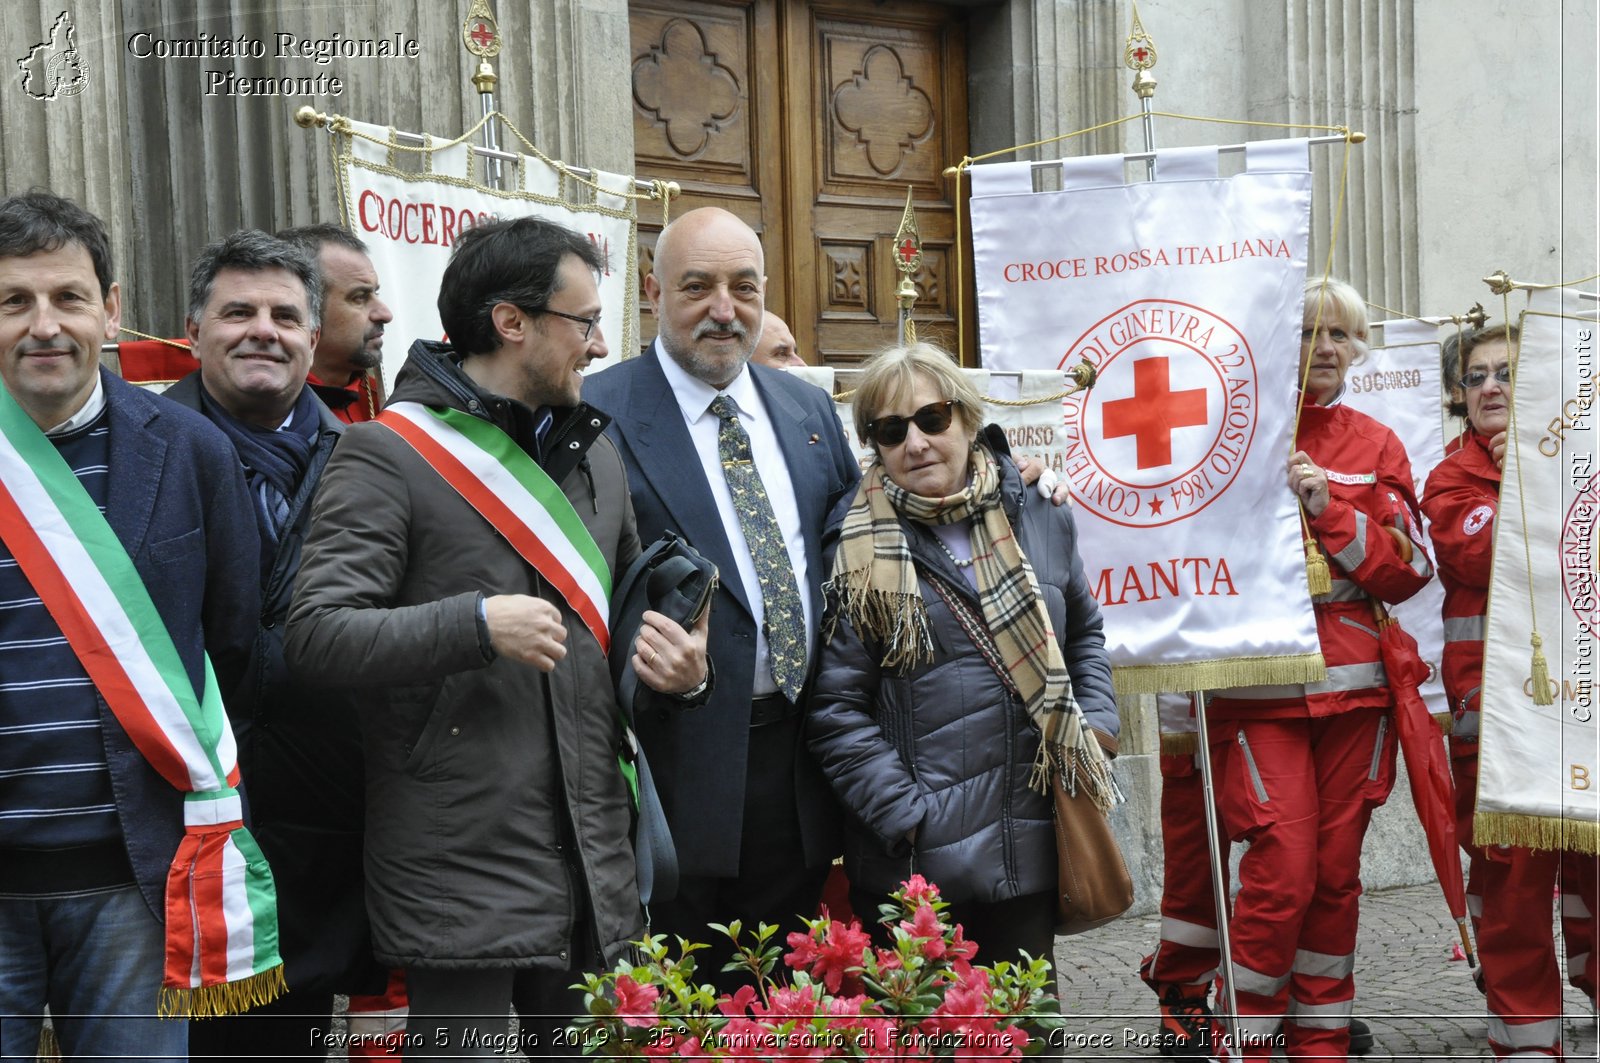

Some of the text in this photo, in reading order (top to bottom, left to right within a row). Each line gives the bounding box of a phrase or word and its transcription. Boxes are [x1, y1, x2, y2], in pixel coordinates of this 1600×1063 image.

[1003, 239, 1291, 283] CROCE ROSSA ITALIANA
[1109, 309, 1216, 350] GINEVRA
[1079, 336, 1111, 368] DI
[1214, 343, 1246, 373] 22
[1351, 368, 1421, 394] SOCCORSO
[1211, 378, 1251, 475] AGOSTO
[1170, 468, 1215, 511] 1864
[1087, 557, 1240, 607] MANTA
